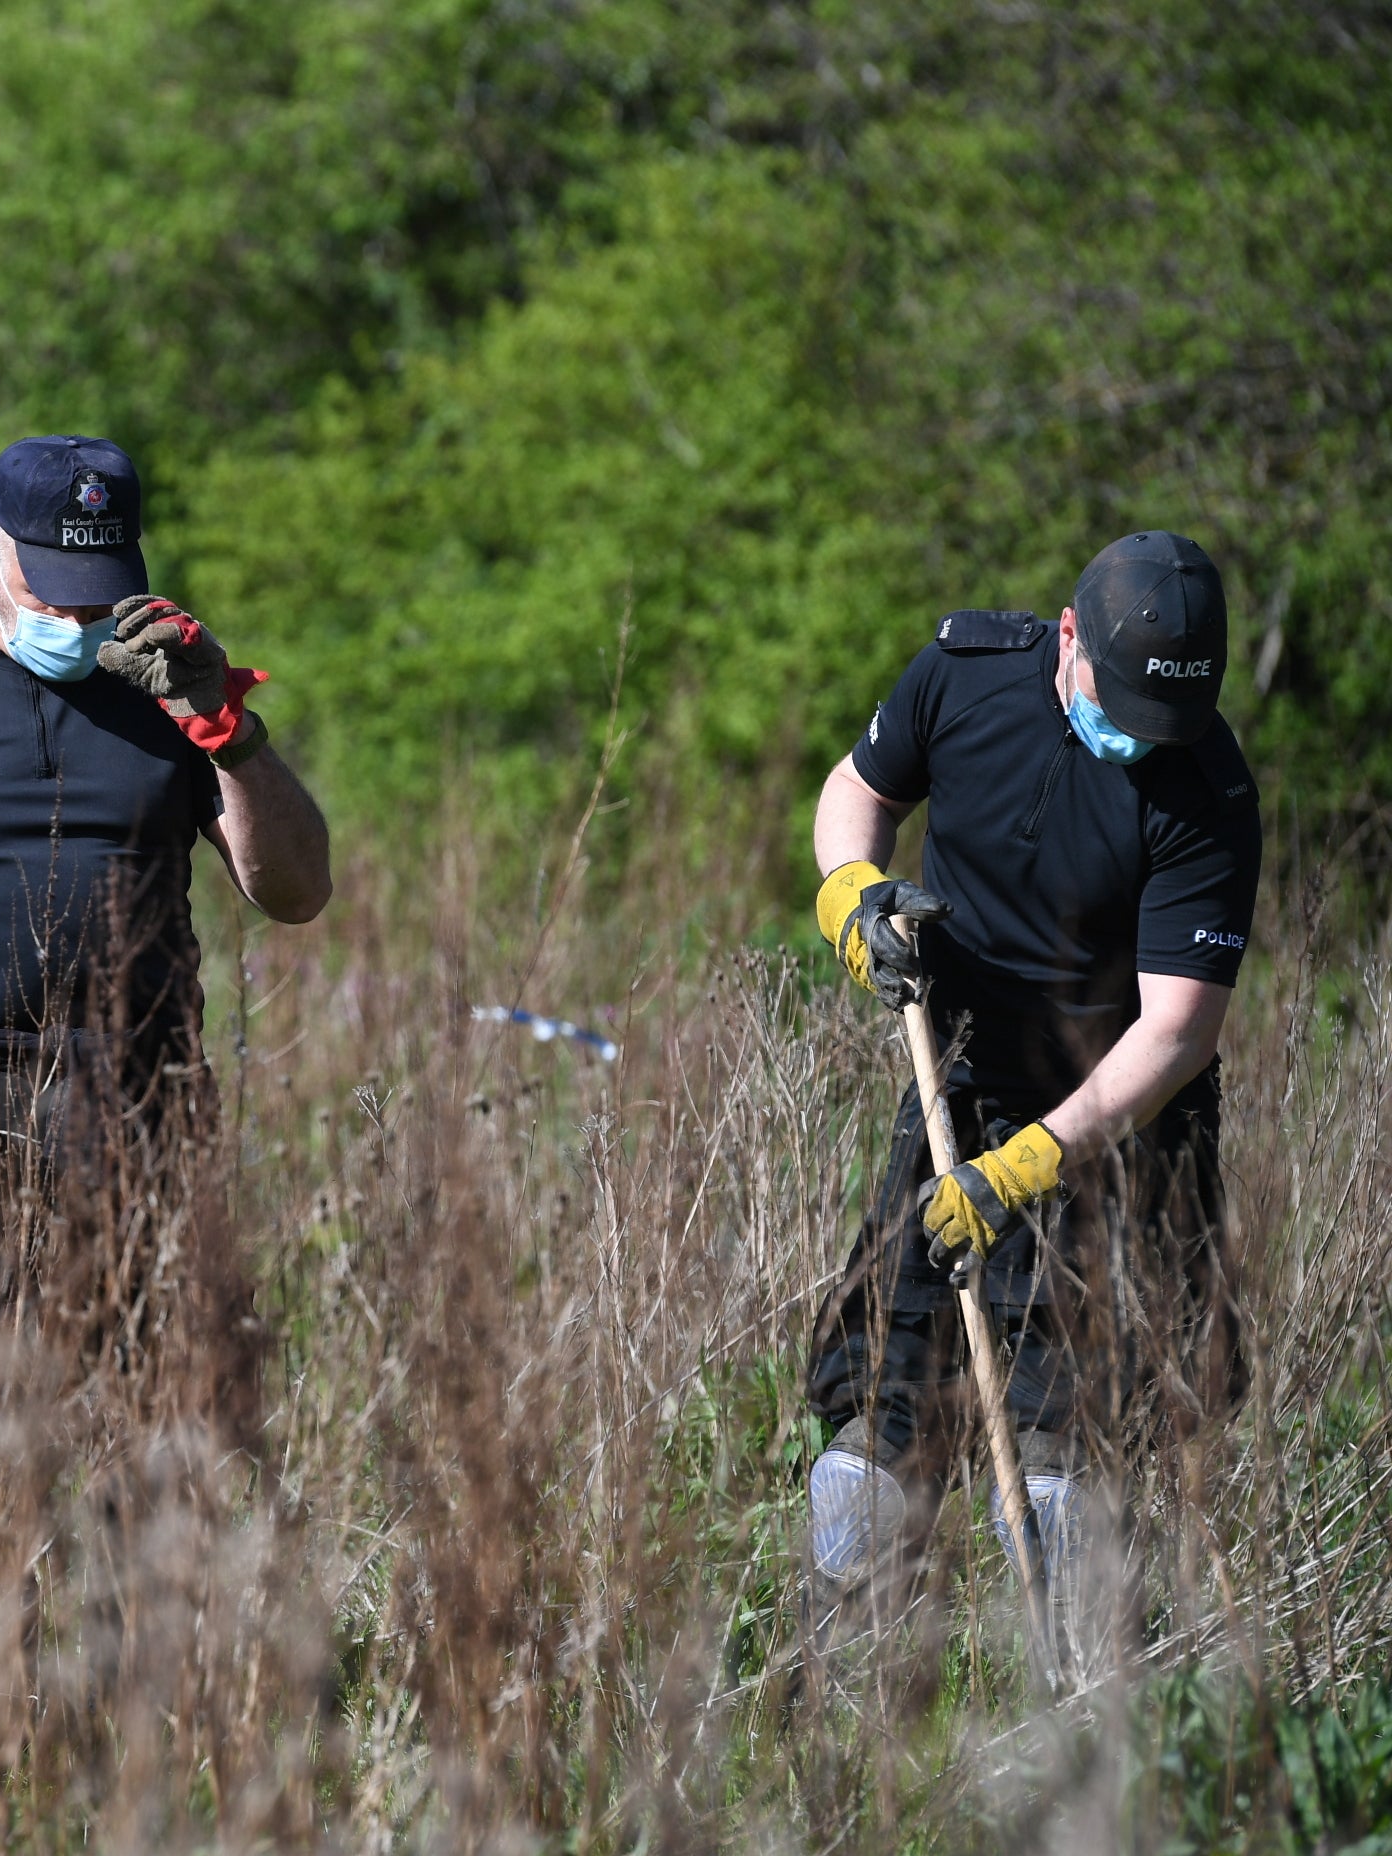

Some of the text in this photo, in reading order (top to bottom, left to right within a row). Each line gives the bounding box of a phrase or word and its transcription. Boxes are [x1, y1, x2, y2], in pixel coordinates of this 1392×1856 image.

[62, 518, 75, 526] Kent
[76, 518, 94, 526] County
[61, 526, 124, 546] POLICE
[1146, 657, 1212, 678] POLICE
[1194, 929, 1245, 949] POLICE
